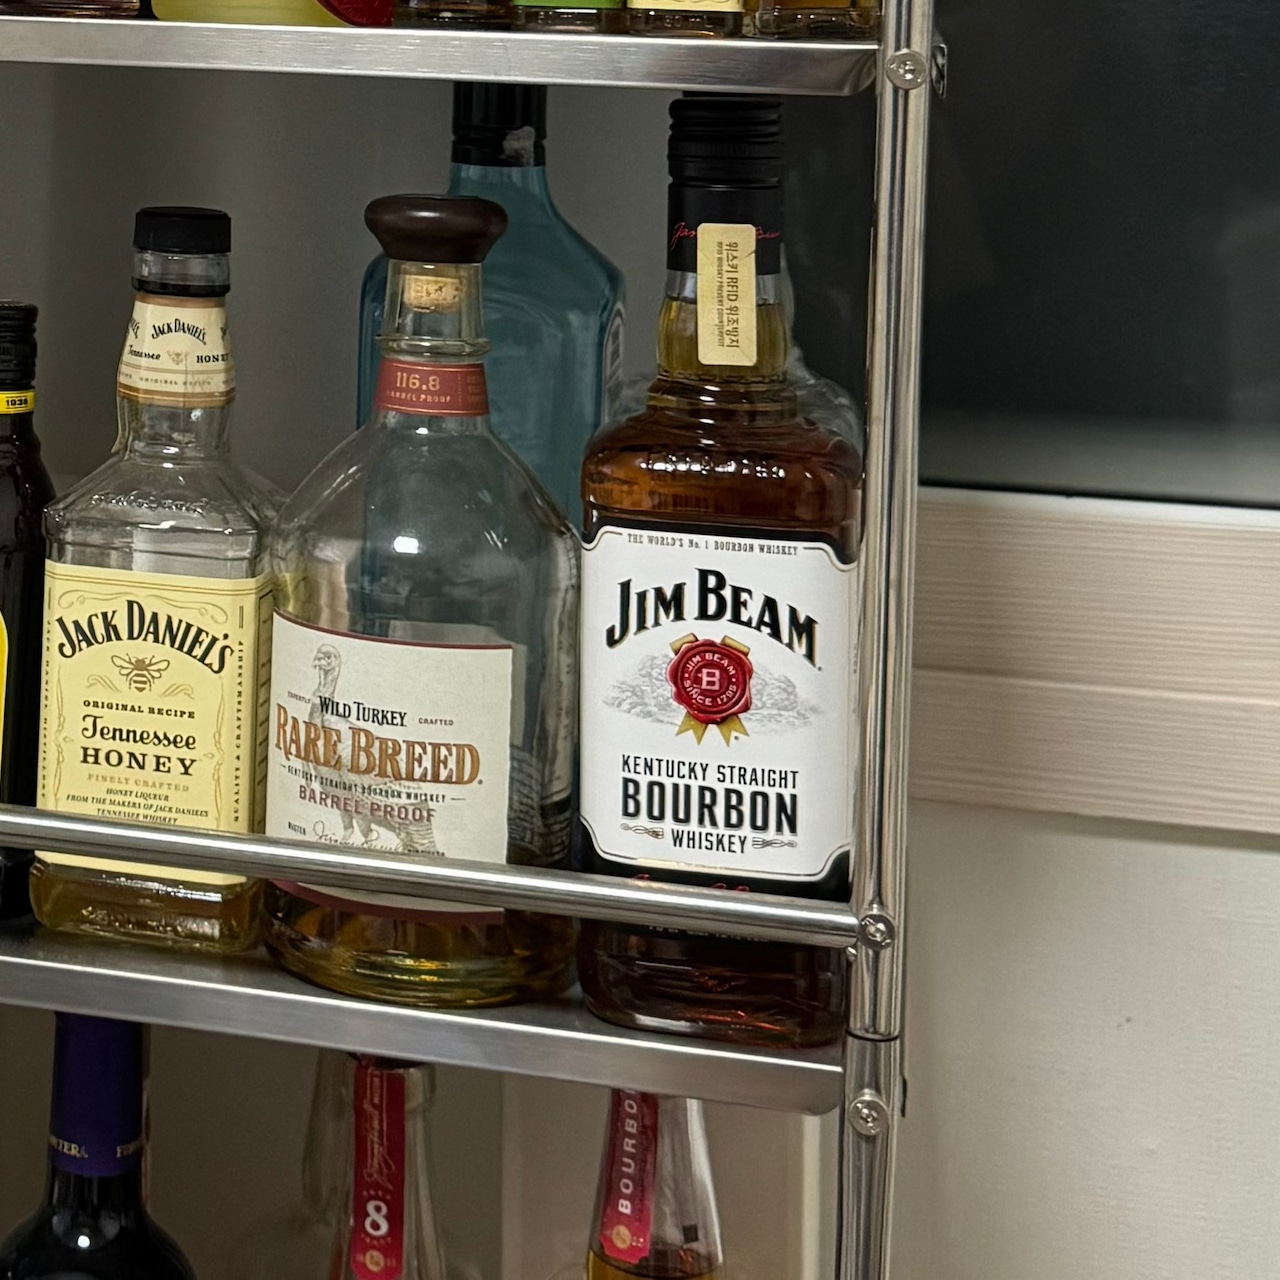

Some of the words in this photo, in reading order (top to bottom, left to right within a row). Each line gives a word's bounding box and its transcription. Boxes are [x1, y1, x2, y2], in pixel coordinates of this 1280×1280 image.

[725, 241, 739, 274] 위스키
[726, 276, 739, 302] RFID
[151, 321, 174, 340] JACK
[174, 318, 207, 346] DANIEL'S
[726, 306, 739, 349] 위조방지
[396, 370, 441, 392] 116.8
[627, 533, 645, 545] THE
[647, 534, 684, 548] WORLD'S
[713, 540, 755, 553] BOURBON
[757, 543, 799, 556] WHISKEY
[605, 578, 687, 649] JIM
[694, 567, 820, 668] BEAM
[56, 609, 121, 659] JACK
[126, 600, 234, 675] DANIEL'S
[685, 655, 702, 671] JIM
[705, 652, 736, 676] BEAM
[700, 668, 721, 690] B
[683, 679, 713, 706] SINCE
[83, 699, 144, 715] ORIGINAL
[148, 705, 196, 719] RECIPE
[319, 695, 351, 719] WILD
[353, 701, 407, 727] TURKEY
[418, 717, 454, 726] CRAFTED
[81, 713, 196, 751] Tennessee
[275, 703, 343, 771] RARE
[347, 726, 482, 786] BREED
[80, 746, 198, 777] HONEY
[622, 753, 709, 782] KENTUCKY
[716, 764, 799, 789] STRAIGHT
[87, 773, 131, 785] FINELY
[106, 787, 133, 798] HONEY
[134, 789, 170, 802] LIQUEUR
[66, 793, 89, 804] FROM
[90, 796, 107, 805] THE
[108, 797, 141, 809] MAKERS
[143, 802, 154, 811] OF
[299, 784, 364, 815] BARREL
[370, 801, 437, 822] PROOF
[622, 777, 798, 837] BOURBON
[671, 827, 748, 854] WHISKEY
[618, 1090, 640, 1215] BOURBO
[364, 1199, 389, 1237] 8
